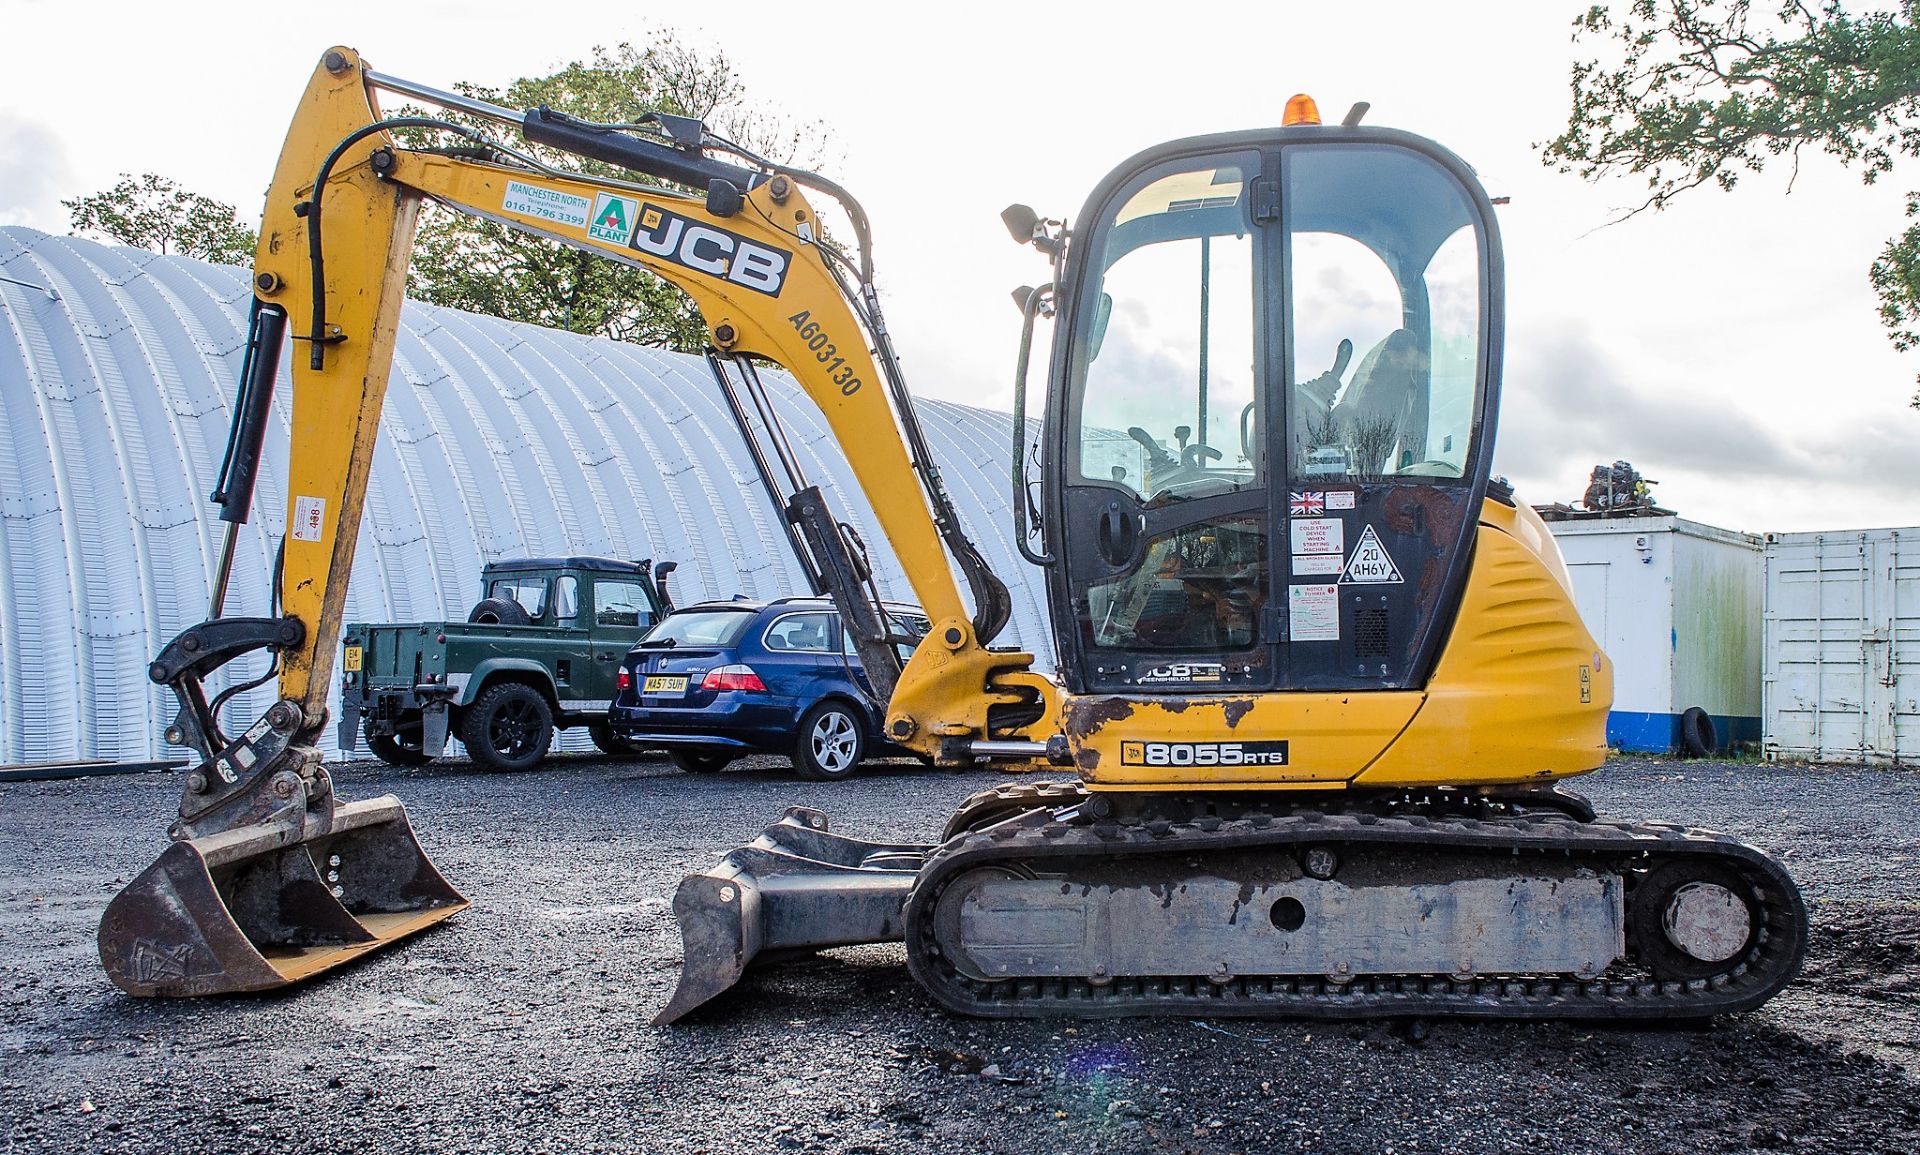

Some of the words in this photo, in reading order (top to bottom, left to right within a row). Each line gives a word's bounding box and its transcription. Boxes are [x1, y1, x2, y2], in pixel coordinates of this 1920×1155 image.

[510, 183, 561, 202] MANCHESTER
[561, 194, 588, 209] NORTH
[505, 200, 556, 218] 0161-796
[558, 212, 585, 225] 3399
[594, 198, 628, 231] A
[589, 226, 629, 243] PLANT
[636, 218, 785, 293] JCB
[788, 310, 861, 396] A603130
[1354, 563, 1386, 576] AH6Y
[647, 679, 667, 689] MA57
[667, 679, 684, 689] SUH
[1146, 743, 1243, 766] 8055
[1244, 752, 1283, 765] RTS
